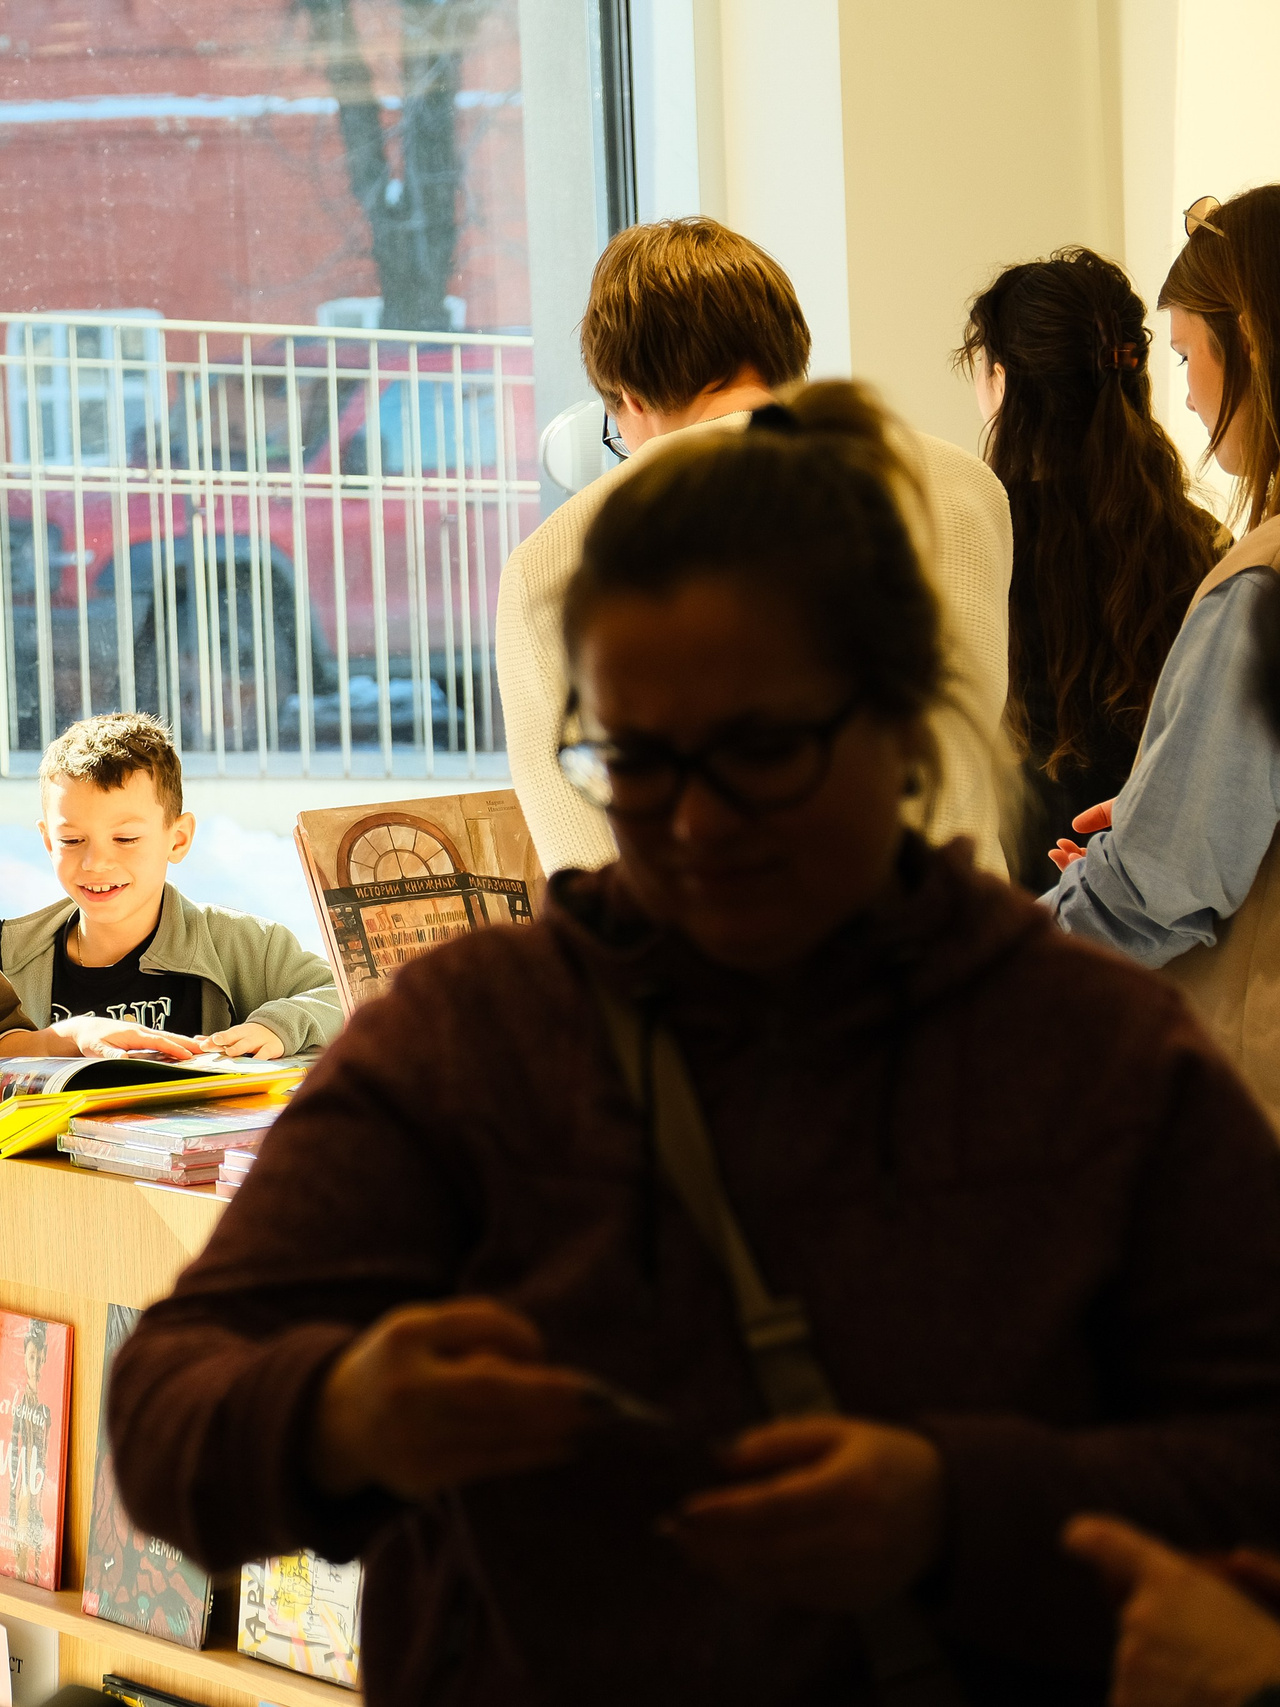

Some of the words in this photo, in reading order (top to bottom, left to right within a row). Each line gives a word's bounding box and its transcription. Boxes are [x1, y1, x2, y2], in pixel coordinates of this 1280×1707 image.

[355, 883, 401, 899] ИСТОРИИ
[404, 877, 459, 893] КНИЖНЫХ
[468, 876, 524, 894] МАГАЗИНОВ
